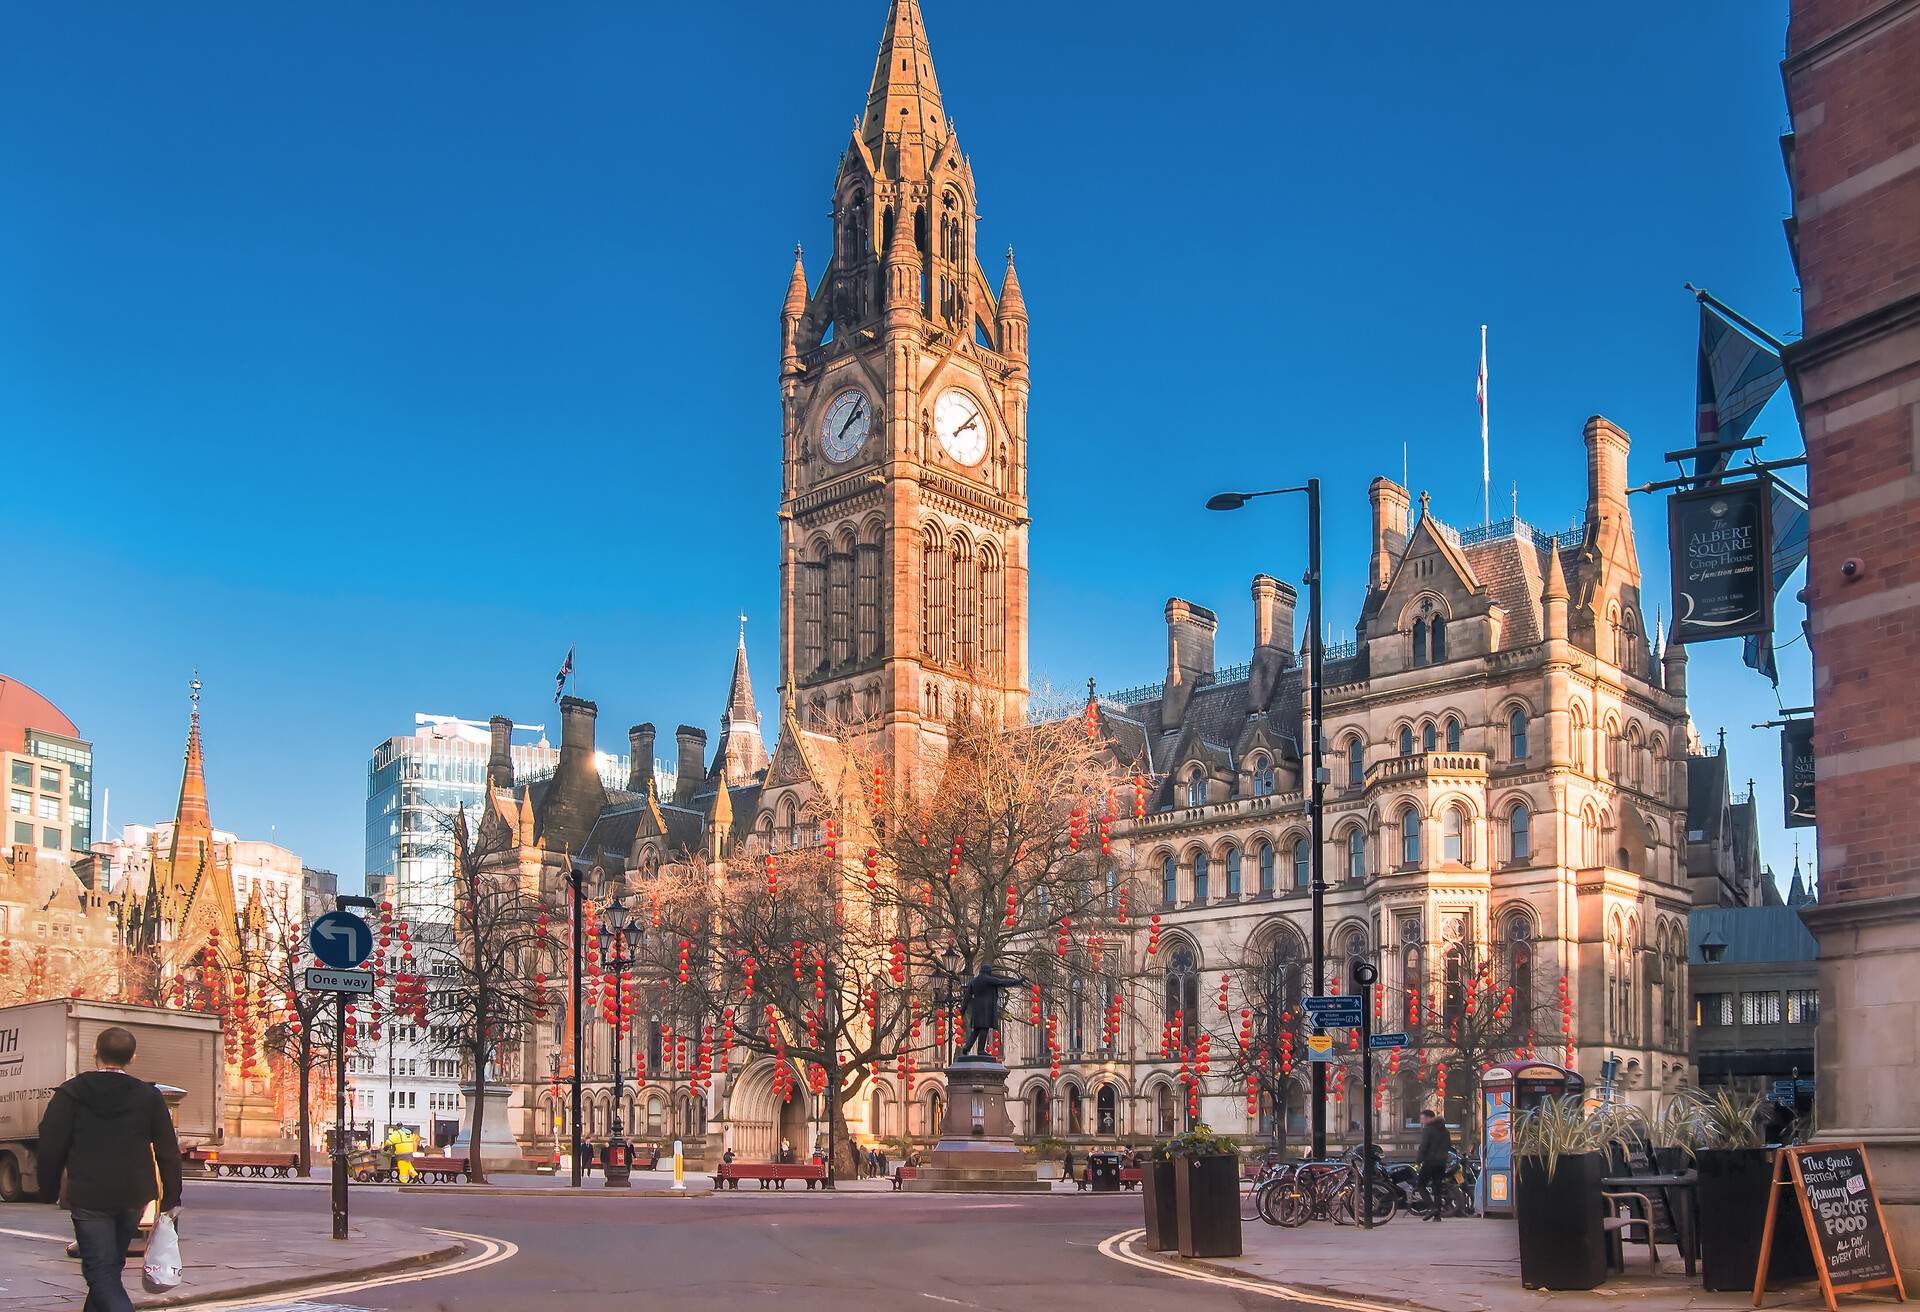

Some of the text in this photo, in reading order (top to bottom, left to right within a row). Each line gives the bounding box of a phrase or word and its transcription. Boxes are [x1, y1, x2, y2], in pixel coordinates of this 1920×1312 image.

[1689, 526, 1752, 545] ALBERT
[1689, 537, 1752, 557] SQUARE
[1690, 552, 1753, 569] Chop House
[1700, 569, 1732, 581] function
[313, 974, 368, 989] One way
[10, 1065, 22, 1077] Ltd
[1803, 1155, 1852, 1171] The Great
[1804, 1171, 1838, 1184] BRITISH
[1807, 1185, 1849, 1210] January
[1820, 1199, 1868, 1218] 50% OFF
[1825, 1215, 1867, 1235] FOOD
[1837, 1234, 1863, 1251] ALL DAY
[1831, 1240, 1870, 1266] EVERY DAY!
